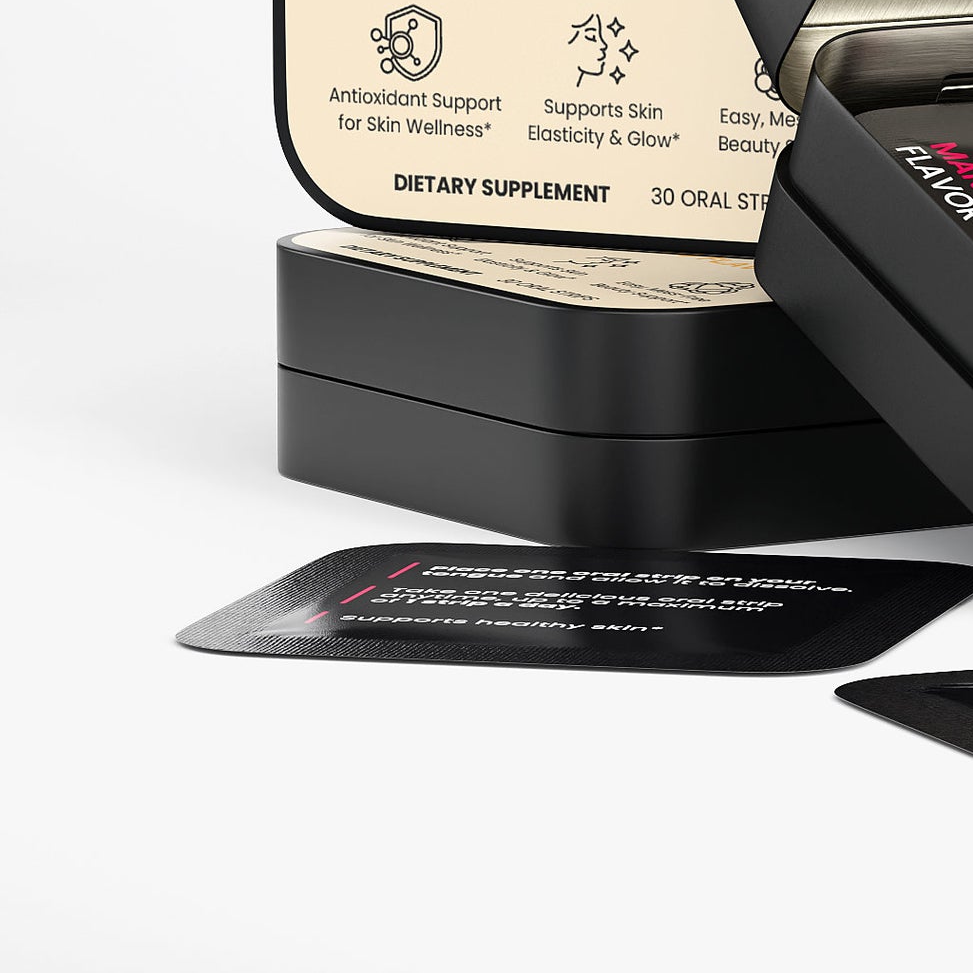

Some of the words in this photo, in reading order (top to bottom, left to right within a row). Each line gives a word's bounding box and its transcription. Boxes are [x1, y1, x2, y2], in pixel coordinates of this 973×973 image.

[330, 87, 427, 107] Antioxidant
[432, 92, 502, 114] Support
[544, 99, 623, 121] Supports
[628, 103, 663, 120] Skin
[338, 114, 362, 131] for
[367, 116, 401, 133] Skin
[720, 108, 765, 130] Easy,
[528, 124, 604, 149] Elasticity
[609, 129, 622, 146] &
[718, 135, 780, 159] Beauty
[394, 174, 477, 195] DIETARY
[482, 179, 610, 203] SUPPLEMENT
[651, 187, 674, 205] 30
[681, 189, 732, 209] ORAL
[422, 571, 523, 579] tongue
[733, 582, 852, 593] dissolve.
[635, 573, 701, 581] strip
[420, 599, 488, 607] strip
[518, 602, 581, 610] day.
[524, 591, 650, 601] delicious
[658, 596, 715, 604] oral
[721, 599, 784, 608] strip
[617, 600, 764, 612] maximum
[340, 615, 469, 624] Supports
[475, 619, 585, 630] healthy
